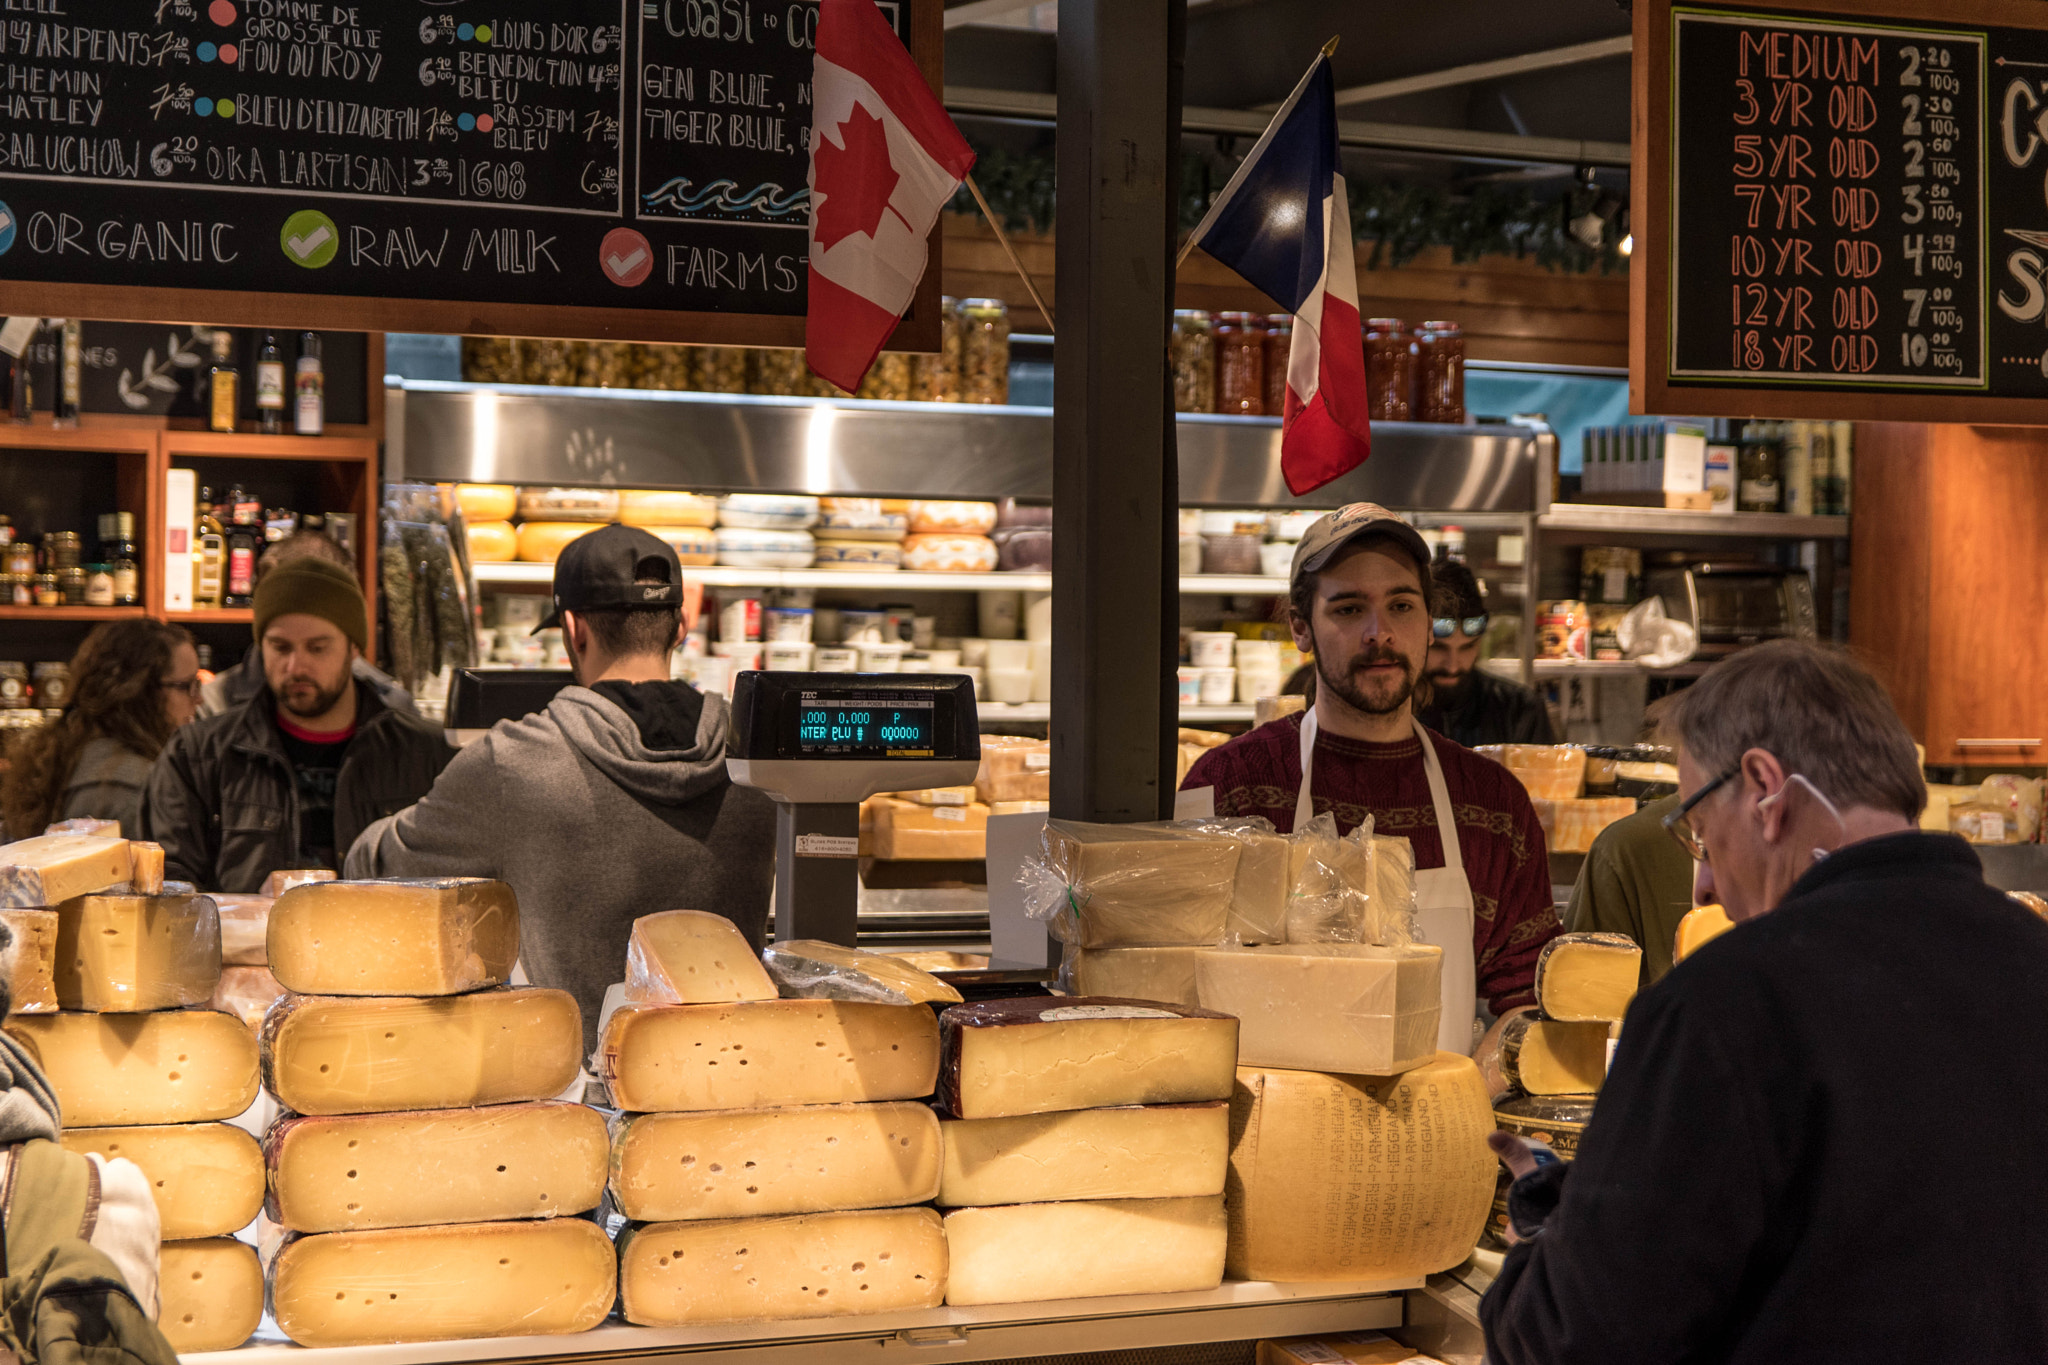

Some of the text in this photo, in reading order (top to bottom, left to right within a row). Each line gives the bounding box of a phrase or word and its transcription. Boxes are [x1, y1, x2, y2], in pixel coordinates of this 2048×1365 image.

[245, 0, 360, 27] TOMME DE
[246, 17, 334, 45] GROSSE
[36, 23, 151, 66] ARPENTS
[491, 18, 545, 50] LOUIS
[550, 22, 589, 54] D'OR
[238, 38, 281, 74] FOU
[321, 43, 382, 82] ROY
[458, 51, 583, 86] BENEDICTIN
[1740, 32, 1879, 86] MEDIUM
[458, 75, 519, 104] BLEU
[1733, 79, 1760, 125] 3
[1769, 81, 1813, 127] YR
[1829, 85, 1877, 132] OLD
[236, 93, 291, 130] BLEU
[297, 99, 420, 141] D'ELIZABETH
[645, 108, 722, 146] TIGER
[494, 127, 549, 152] BLEU
[1733, 135, 1764, 178] 5
[1769, 134, 1816, 178] YR
[1829, 136, 1880, 179] OLD
[206, 146, 267, 184] OKA
[279, 149, 407, 195] L'ARTISAN
[458, 158, 527, 200] 1608
[1734, 184, 1765, 228] 7
[1770, 184, 1816, 230] YR
[1832, 186, 1880, 232] OLD
[28, 211, 238, 264] ORGANIC
[350, 225, 560, 274] RAW MILK
[1732, 235, 1765, 278] 10
[1771, 237, 1823, 276] YR
[1834, 239, 1881, 279] OLD
[1733, 282, 1767, 325] 12
[1773, 286, 1815, 330] YR
[1833, 286, 1879, 330] OLD
[1733, 330, 1764, 370] 18
[1772, 335, 1817, 371] YR
[1831, 335, 1879, 373] OLD
[801, 691, 817, 699] TEC
[831, 726, 851, 741] PLU
[881, 726, 919, 740] 000000
[838, 712, 870, 724] 0.000
